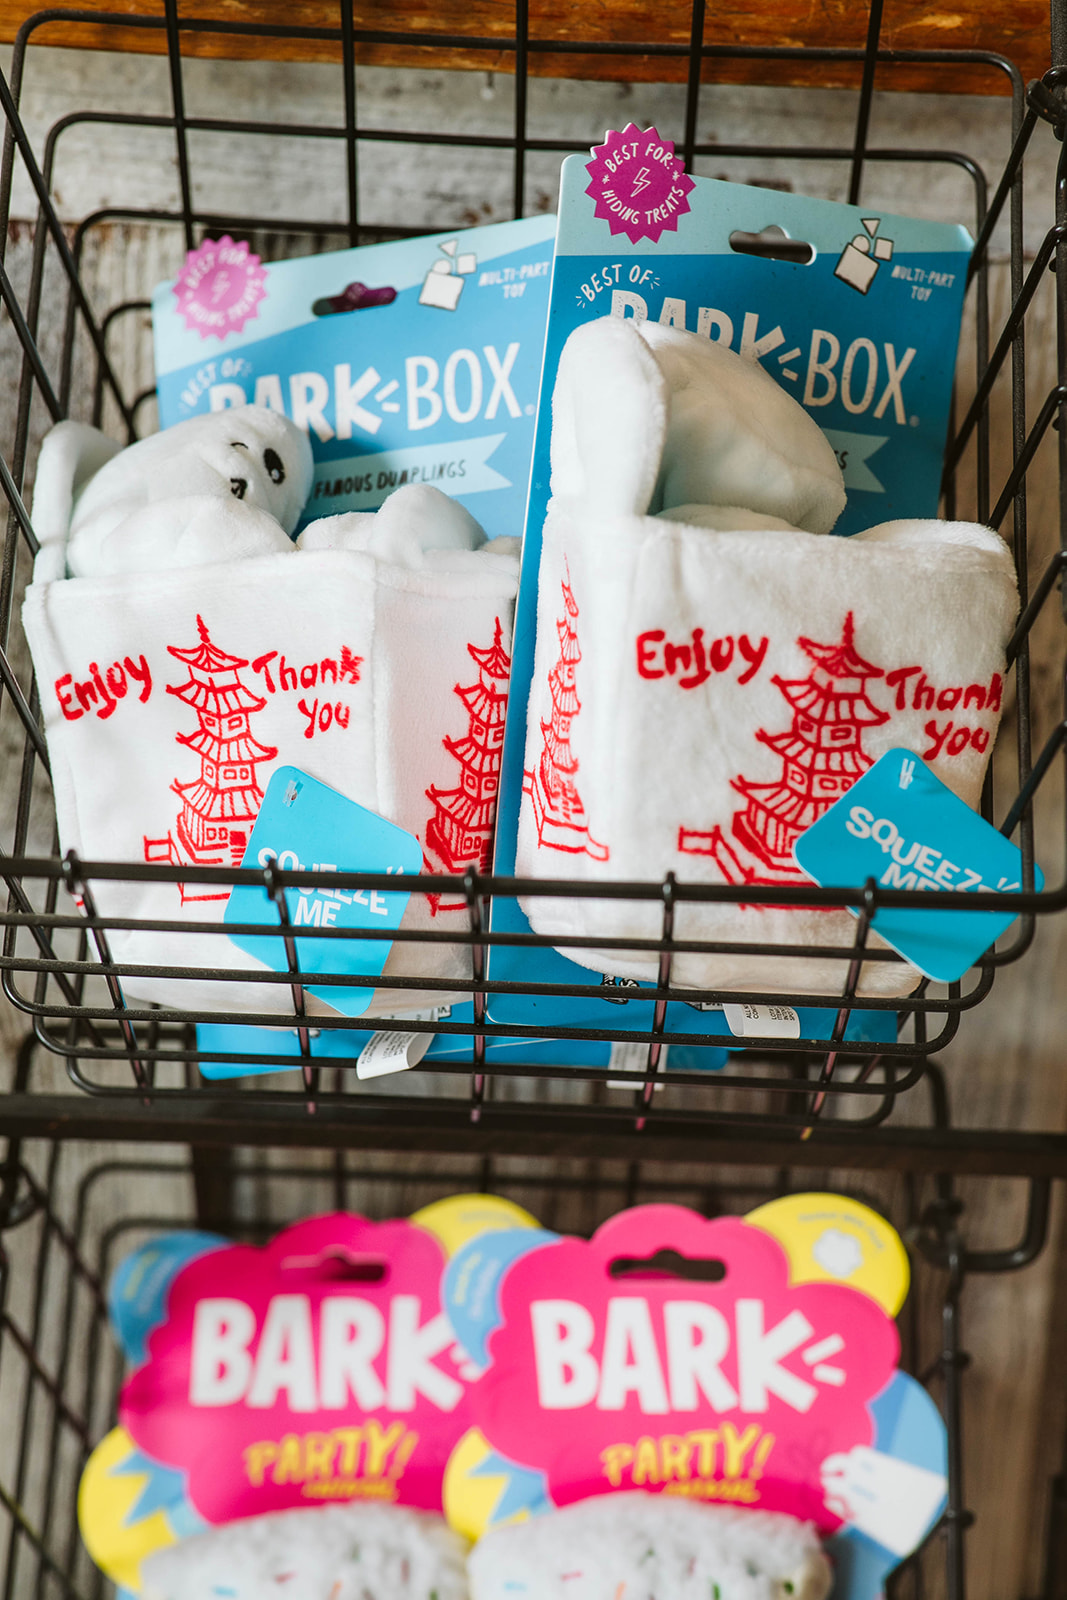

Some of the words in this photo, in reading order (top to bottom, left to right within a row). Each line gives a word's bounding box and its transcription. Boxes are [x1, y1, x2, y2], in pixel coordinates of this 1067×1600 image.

[603, 142, 639, 173] BEST
[645, 142, 674, 170] FOR:
[601, 189, 641, 225] HIDING
[644, 185, 685, 225] TREATS
[477, 260, 550, 287] MULTI-PART
[503, 282, 527, 299] TOY
[580, 263, 622, 302] BEST
[628, 264, 654, 285] OF
[891, 265, 956, 288] MULTI-PART
[911, 285, 933, 302] TOY
[404, 342, 523, 431] BOX
[803, 328, 917, 426] BOX
[313, 475, 373, 499] FAMOUS
[376, 459, 467, 491] DUMPLINGS
[251, 644, 365, 694] Thank
[636, 627, 769, 690] Enjoy
[54, 654, 153, 720] Enjoy
[845, 805, 1002, 894] SQUEEZ
[293, 896, 342, 929] ME
[189, 1293, 465, 1413] BARK
[529, 1296, 819, 1415] BARK
[242, 1417, 420, 1487] PARTY!
[601, 1420, 777, 1487] PARTY!
